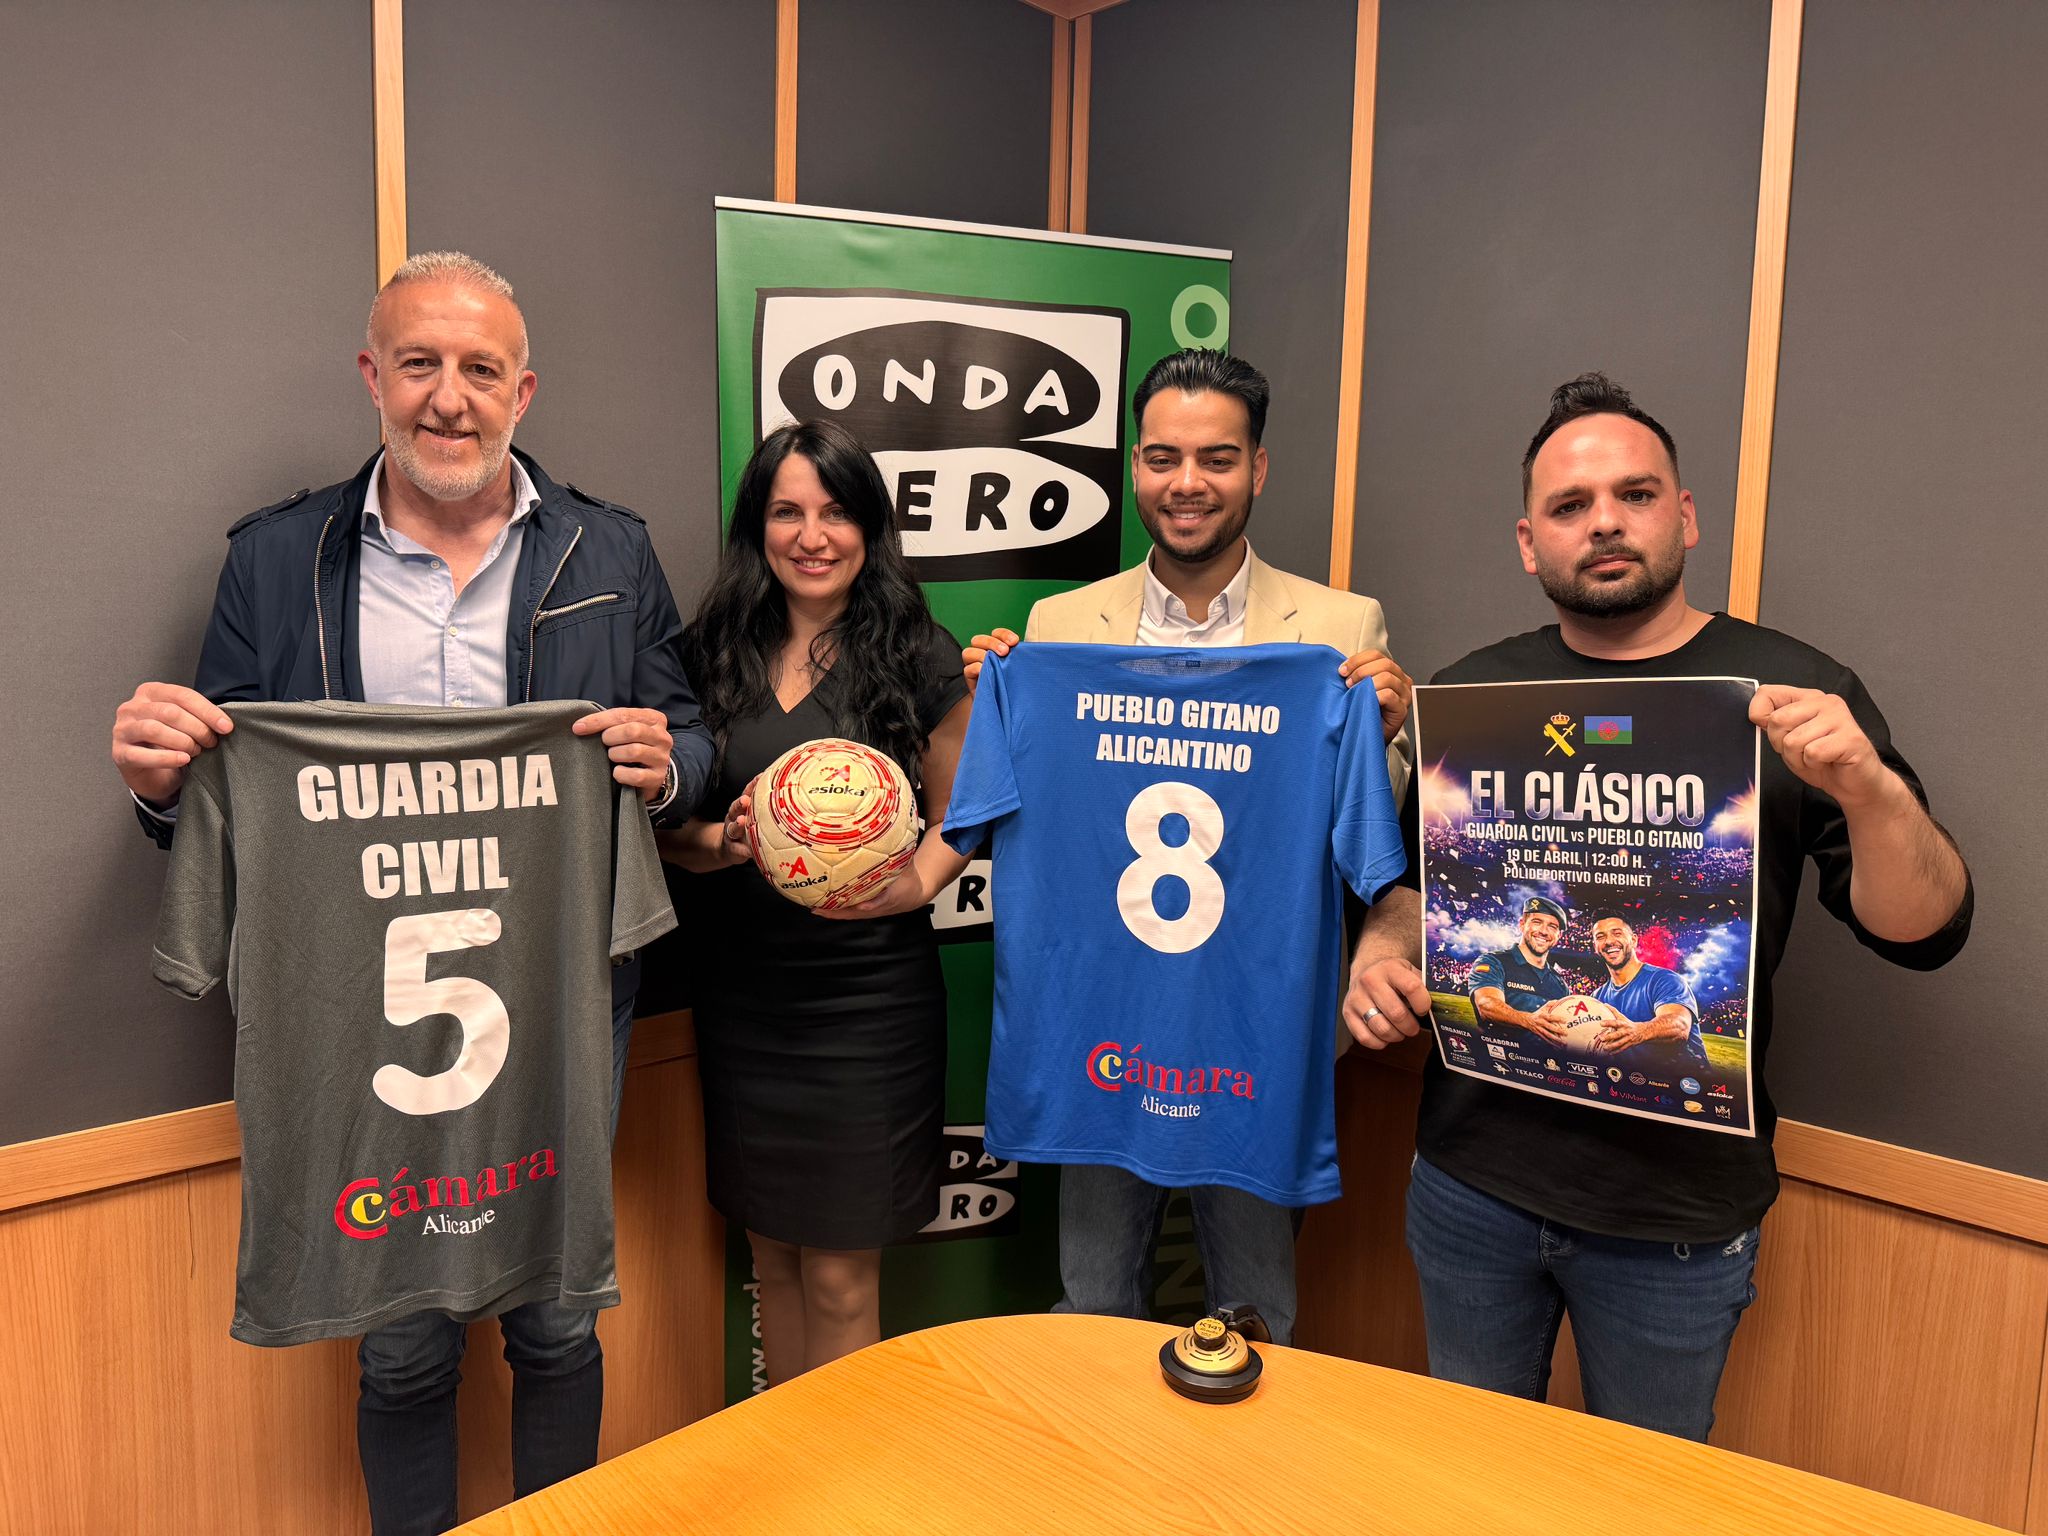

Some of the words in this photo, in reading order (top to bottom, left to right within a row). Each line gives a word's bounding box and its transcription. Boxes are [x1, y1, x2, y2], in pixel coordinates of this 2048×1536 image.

[813, 354, 1070, 416] ONDA
[899, 469, 1070, 532] ERO
[1076, 692, 1175, 726] PUEBLO
[1181, 700, 1280, 734] GITANO
[1096, 734, 1252, 773] ALICANTINO
[297, 754, 558, 822] GUARDIA
[808, 783, 865, 797] asioka
[1470, 770, 1515, 818] EL
[1524, 763, 1705, 827] CLÁSICO
[1467, 823, 1529, 842] GUARDIA
[1531, 825, 1569, 844] CIVIL
[1588, 827, 1645, 847] PUEBLO
[1648, 830, 1704, 850] GITANO
[361, 836, 509, 899] CIVIL
[1117, 781, 1225, 954] 8
[1506, 848, 1520, 862] 19
[1524, 849, 1540, 863] DE
[1544, 850, 1582, 866] ABRIL
[1592, 853, 1629, 868] 12:00
[1632, 855, 1647, 869] H.
[781, 873, 829, 890] asioka
[1504, 866, 1591, 884] POLIDEPORTIVO
[1594, 872, 1653, 887] GARBINET
[1507, 981, 1535, 992] GUARDIA
[372, 908, 510, 1116] 5
[1566, 1014, 1602, 1028] asioka
[1515, 1068, 1544, 1080] TEXACO
[1141, 1094, 1200, 1118] Alicante
[422, 1207, 496, 1237] Alicante
